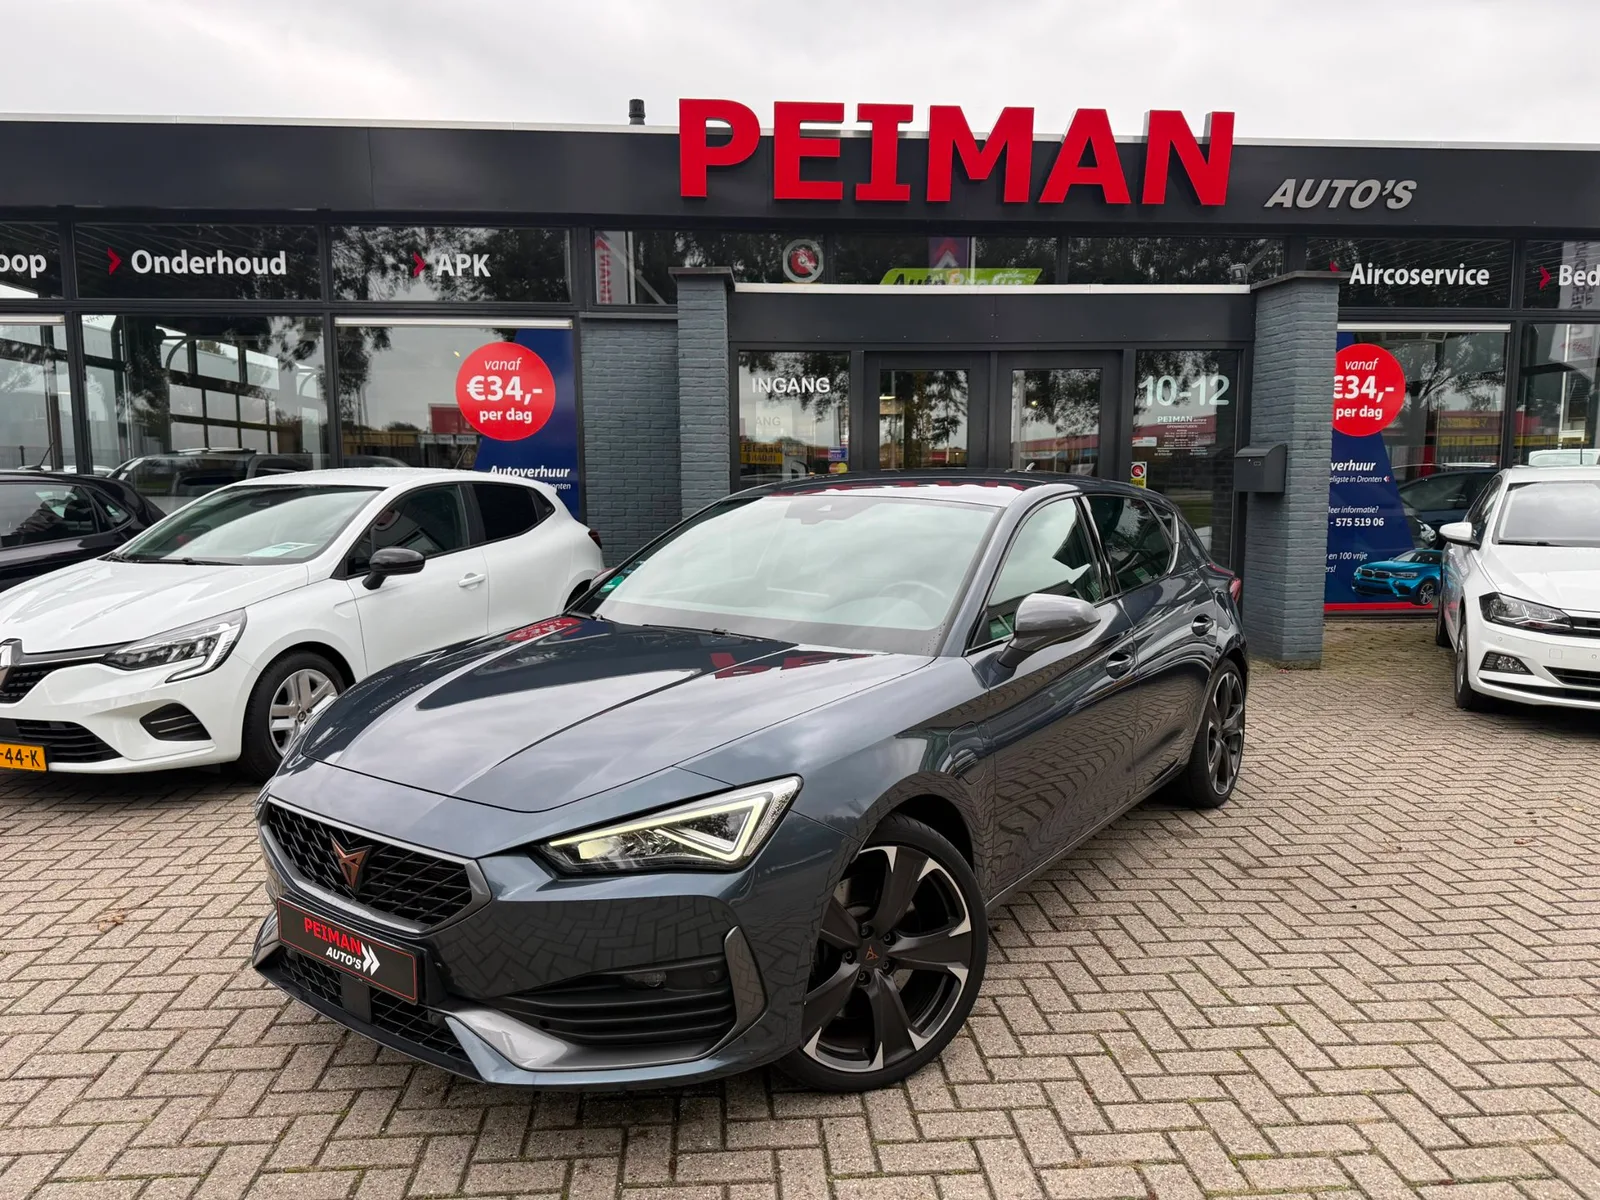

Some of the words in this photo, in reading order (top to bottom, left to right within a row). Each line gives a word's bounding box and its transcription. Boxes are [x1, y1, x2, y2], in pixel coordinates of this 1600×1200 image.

[679, 98, 1235, 206] PEIMAN
[1264, 178, 1417, 210] AUTO'S
[131, 250, 287, 275] Onderhoud
[436, 254, 491, 277] APK
[1349, 262, 1490, 286] Aircoservice
[484, 357, 522, 371] vanaf
[1345, 357, 1379, 371] vanaf
[467, 375, 543, 405] €34,-
[752, 377, 831, 394] INGANG
[1139, 375, 1230, 406] 10-12
[479, 409, 503, 423] per
[506, 408, 533, 423] dag
[1157, 415, 1194, 423] PEIMAN
[1336, 408, 1357, 420] per
[1359, 405, 1383, 420] dag
[489, 465, 571, 478] Autoverhuur
[1331, 459, 1376, 471] verhuur
[1357, 475, 1383, 483] Dronten
[1341, 505, 1379, 513] informatie?
[1335, 517, 1353, 527] 575
[1354, 517, 1371, 527] 519
[1372, 517, 1385, 527] 06
[1340, 552, 1352, 560] 100
[1353, 552, 1368, 561] vrije
[304, 917, 361, 956] PEIMAN
[326, 946, 362, 970] AUTO'S
